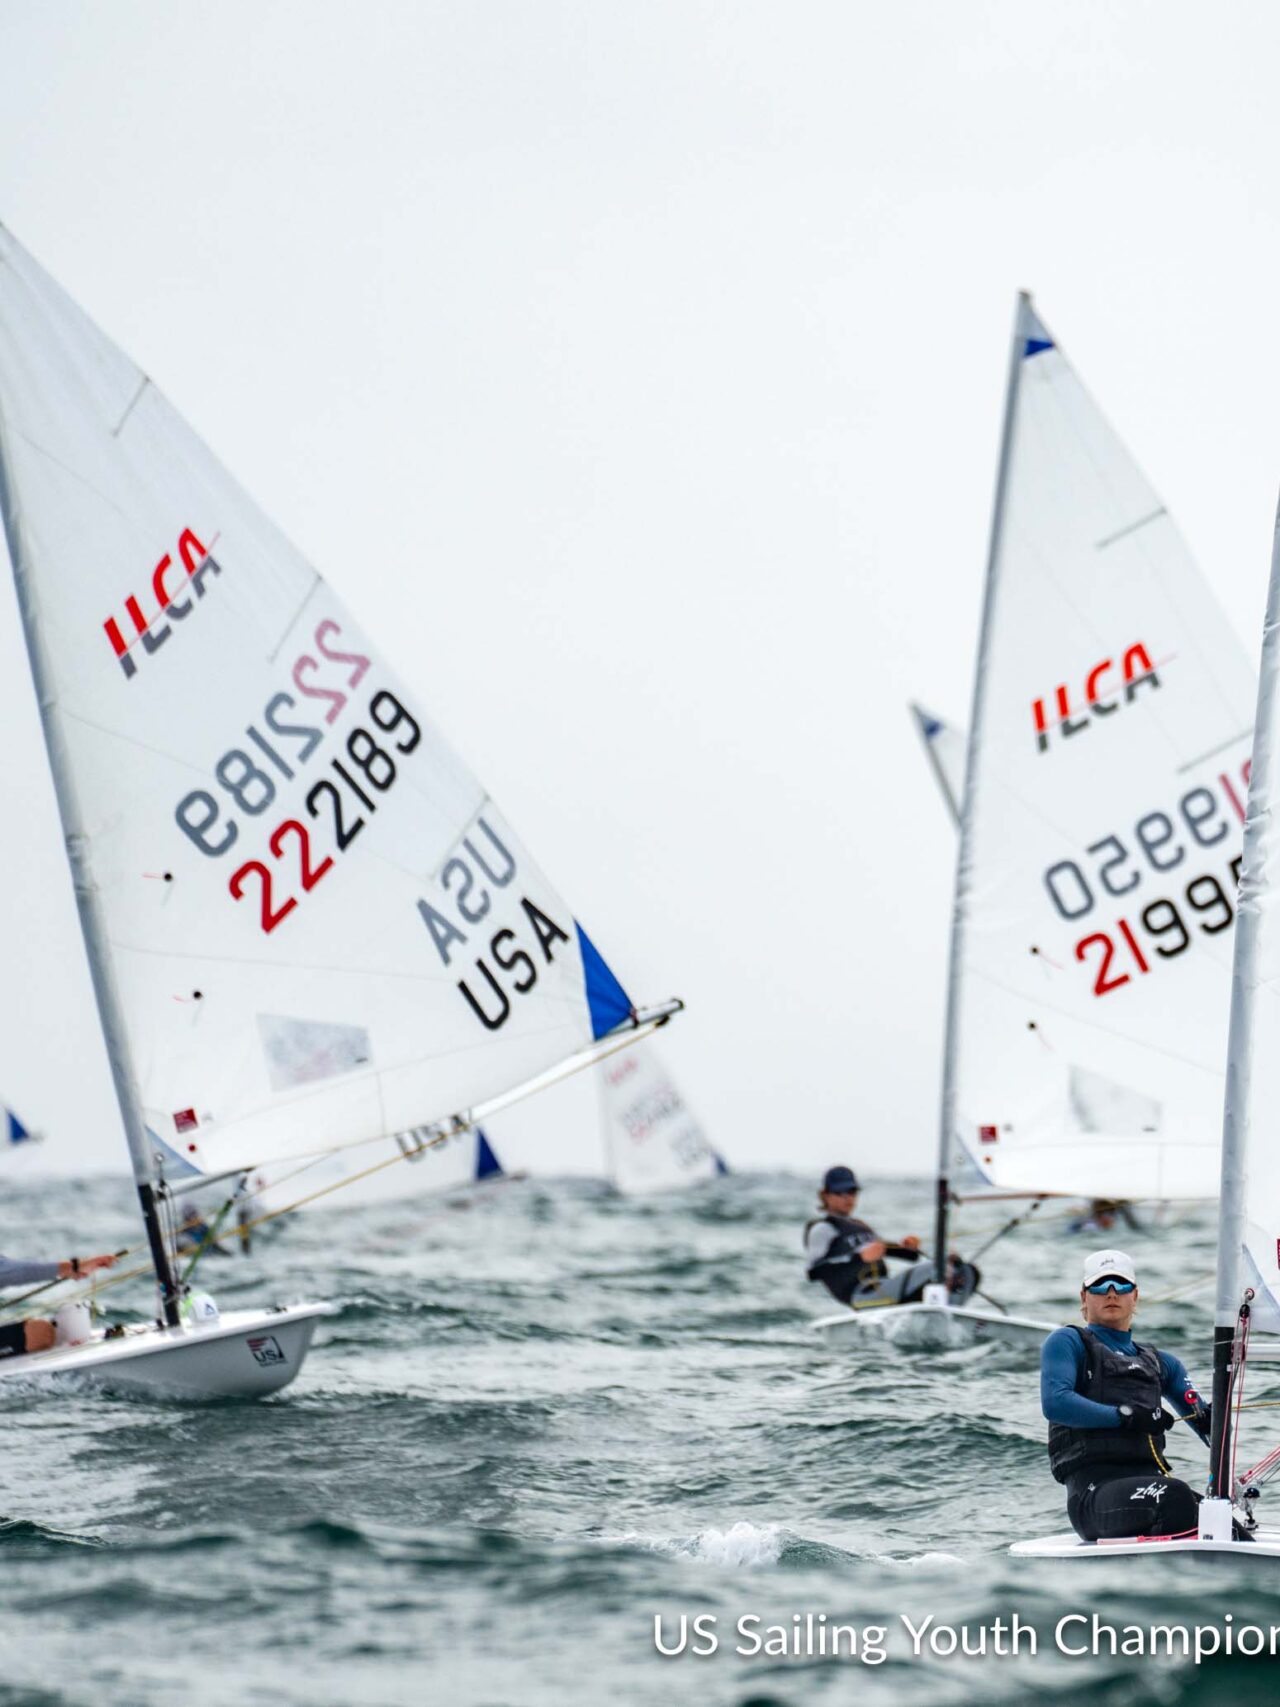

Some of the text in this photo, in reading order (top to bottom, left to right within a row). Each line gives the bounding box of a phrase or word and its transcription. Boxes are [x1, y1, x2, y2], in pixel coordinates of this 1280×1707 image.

[103, 527, 222, 680] ILCA
[1030, 641, 1163, 754] ILCA
[228, 689, 422, 935] 222189
[457, 896, 571, 1032] USA
